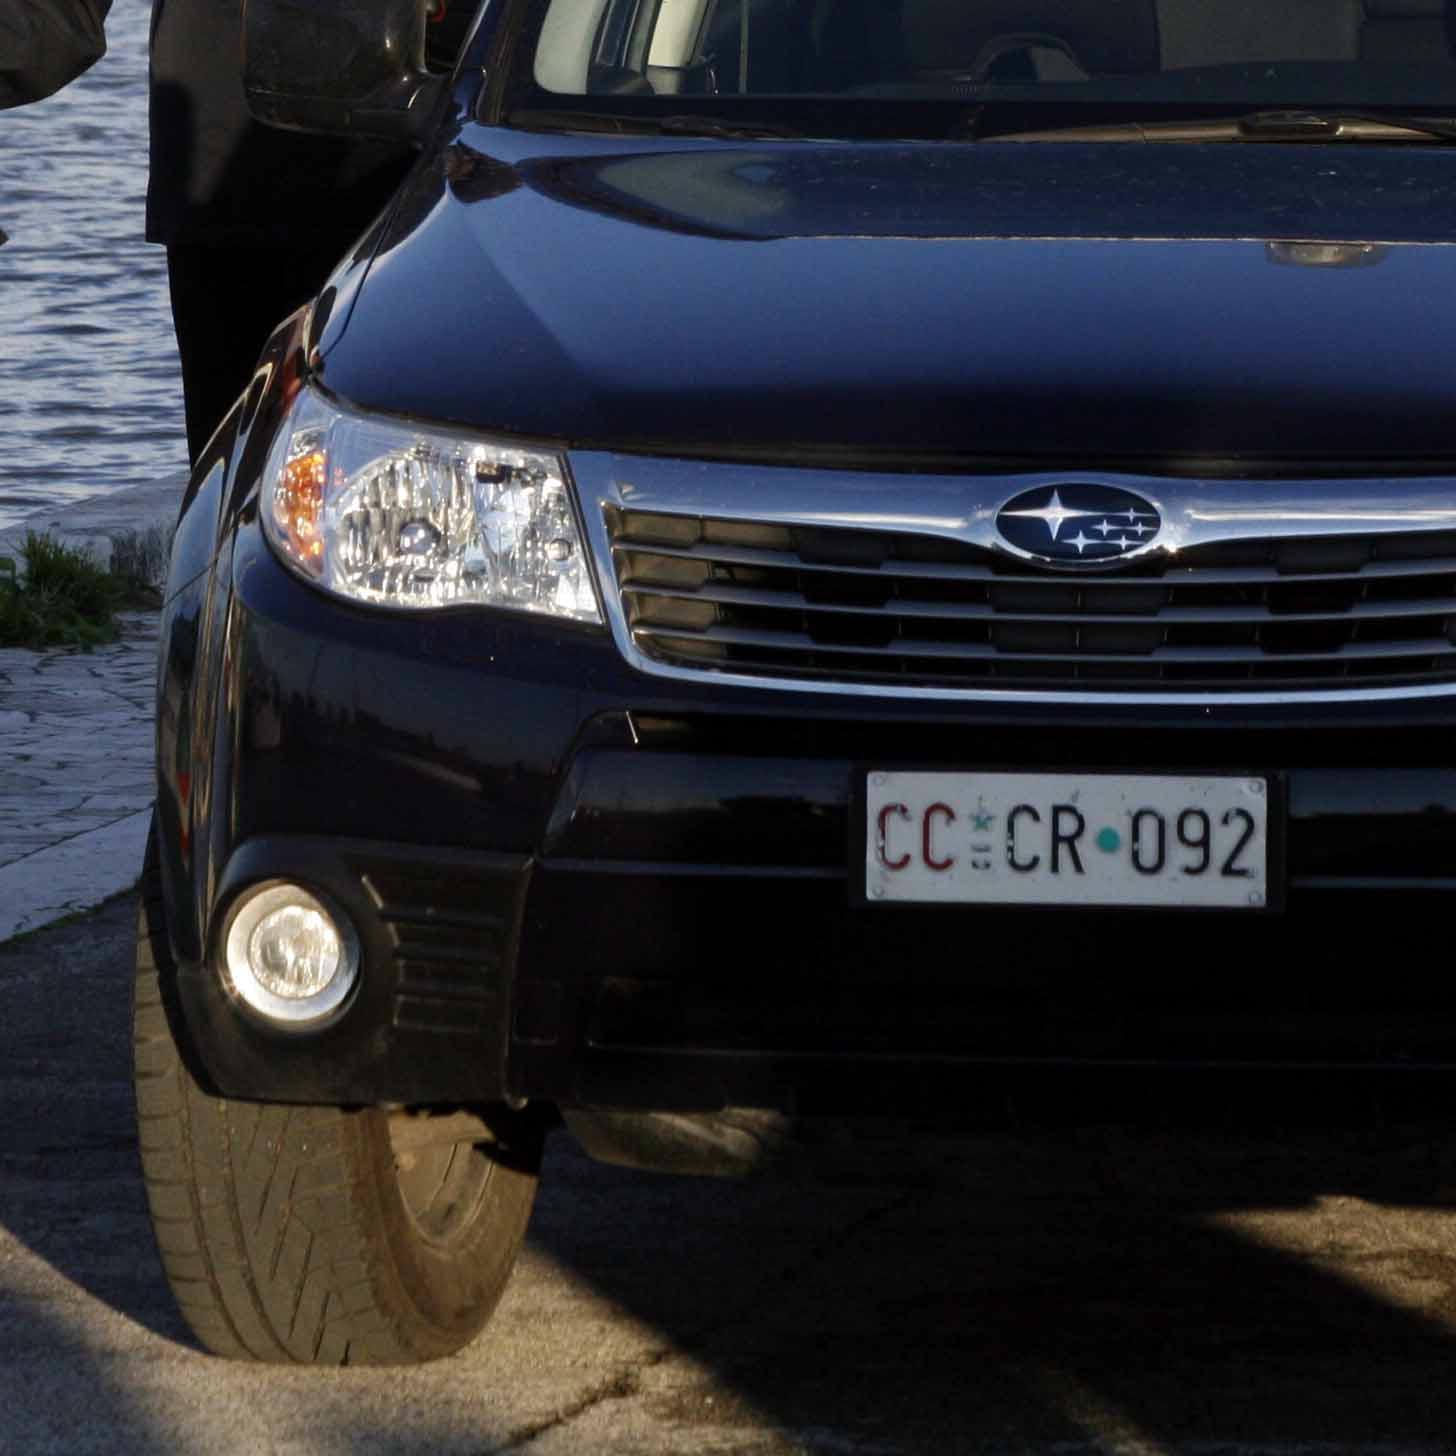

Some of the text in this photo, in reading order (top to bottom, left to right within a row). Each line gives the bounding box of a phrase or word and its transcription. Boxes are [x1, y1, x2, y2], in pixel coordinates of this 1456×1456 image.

[876, 802, 1257, 878] CC CR 092
